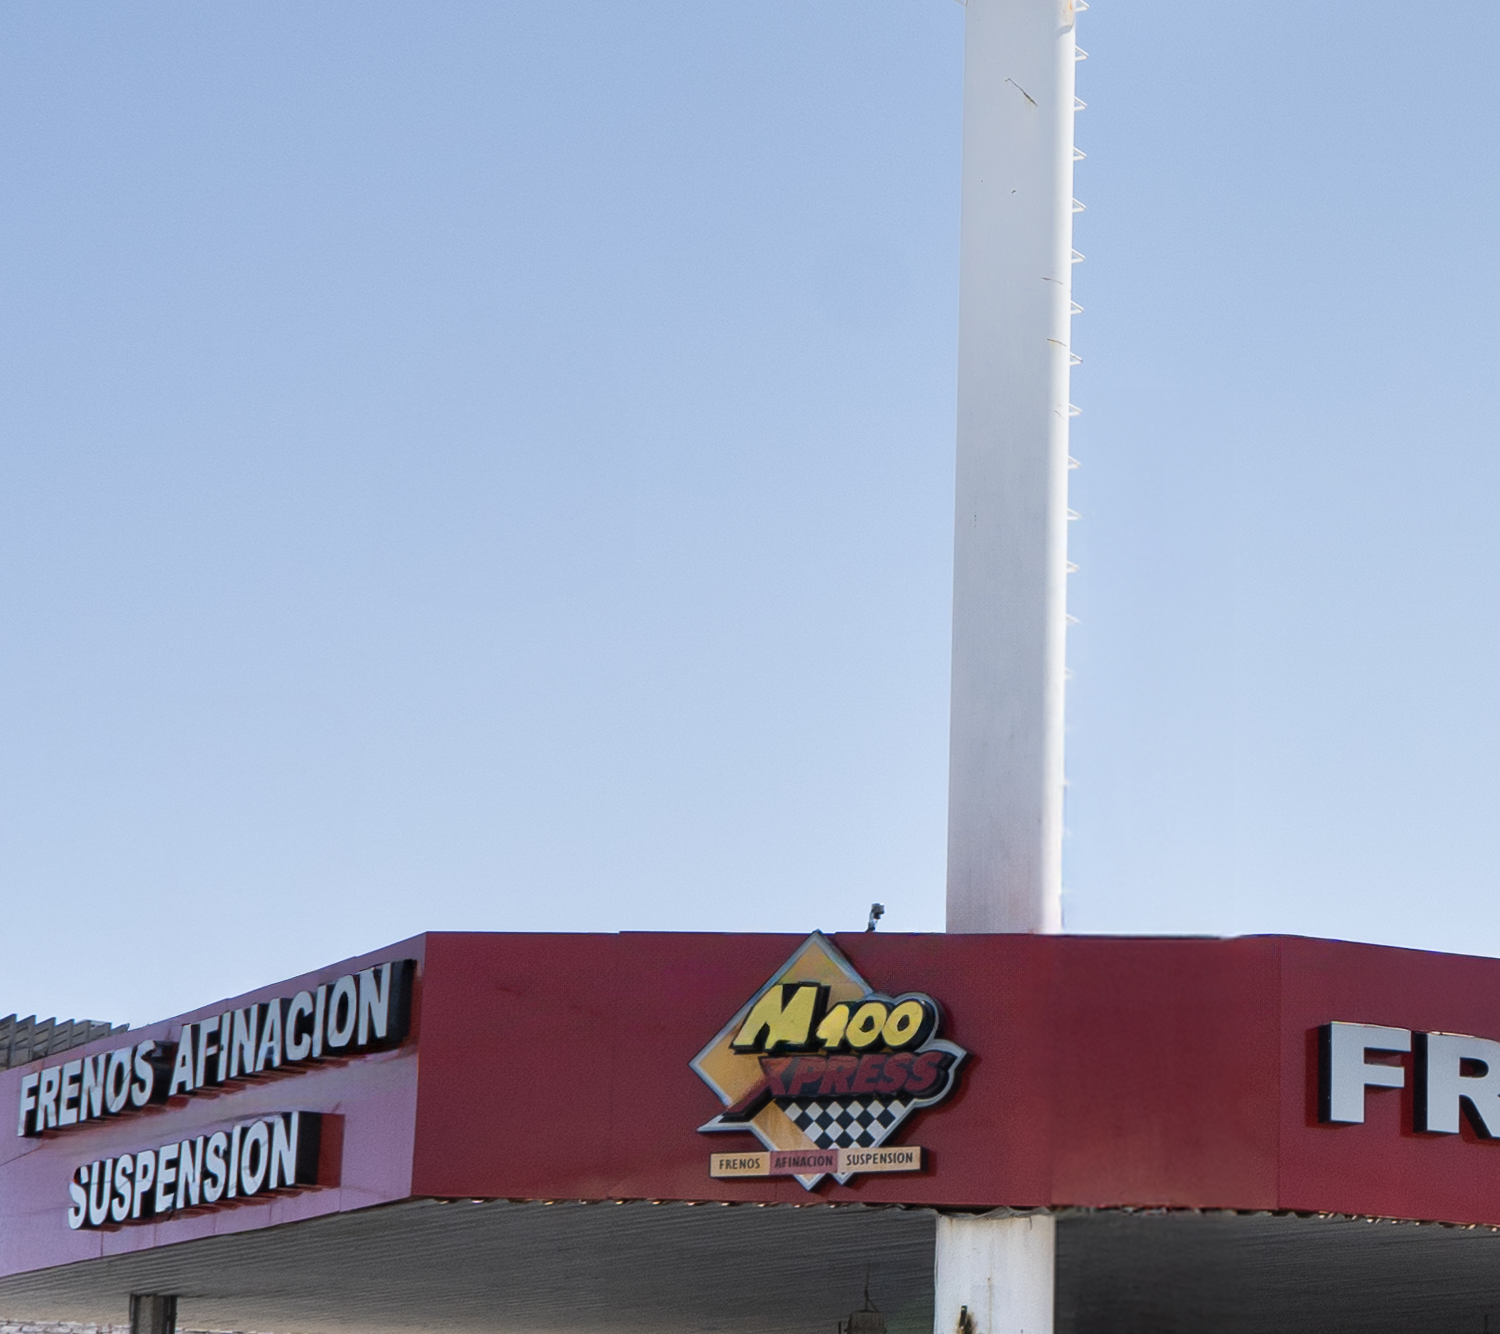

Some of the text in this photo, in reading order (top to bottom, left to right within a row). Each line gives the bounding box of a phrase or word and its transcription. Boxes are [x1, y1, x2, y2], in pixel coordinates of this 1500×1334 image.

[16, 961, 393, 1137] FRENOS AFINACION
[726, 1050, 943, 1114] XPRESS
[66, 1110, 301, 1231] SUSPENSION
[719, 1152, 914, 1171] FRENOS AFINACION SUSPENSION
